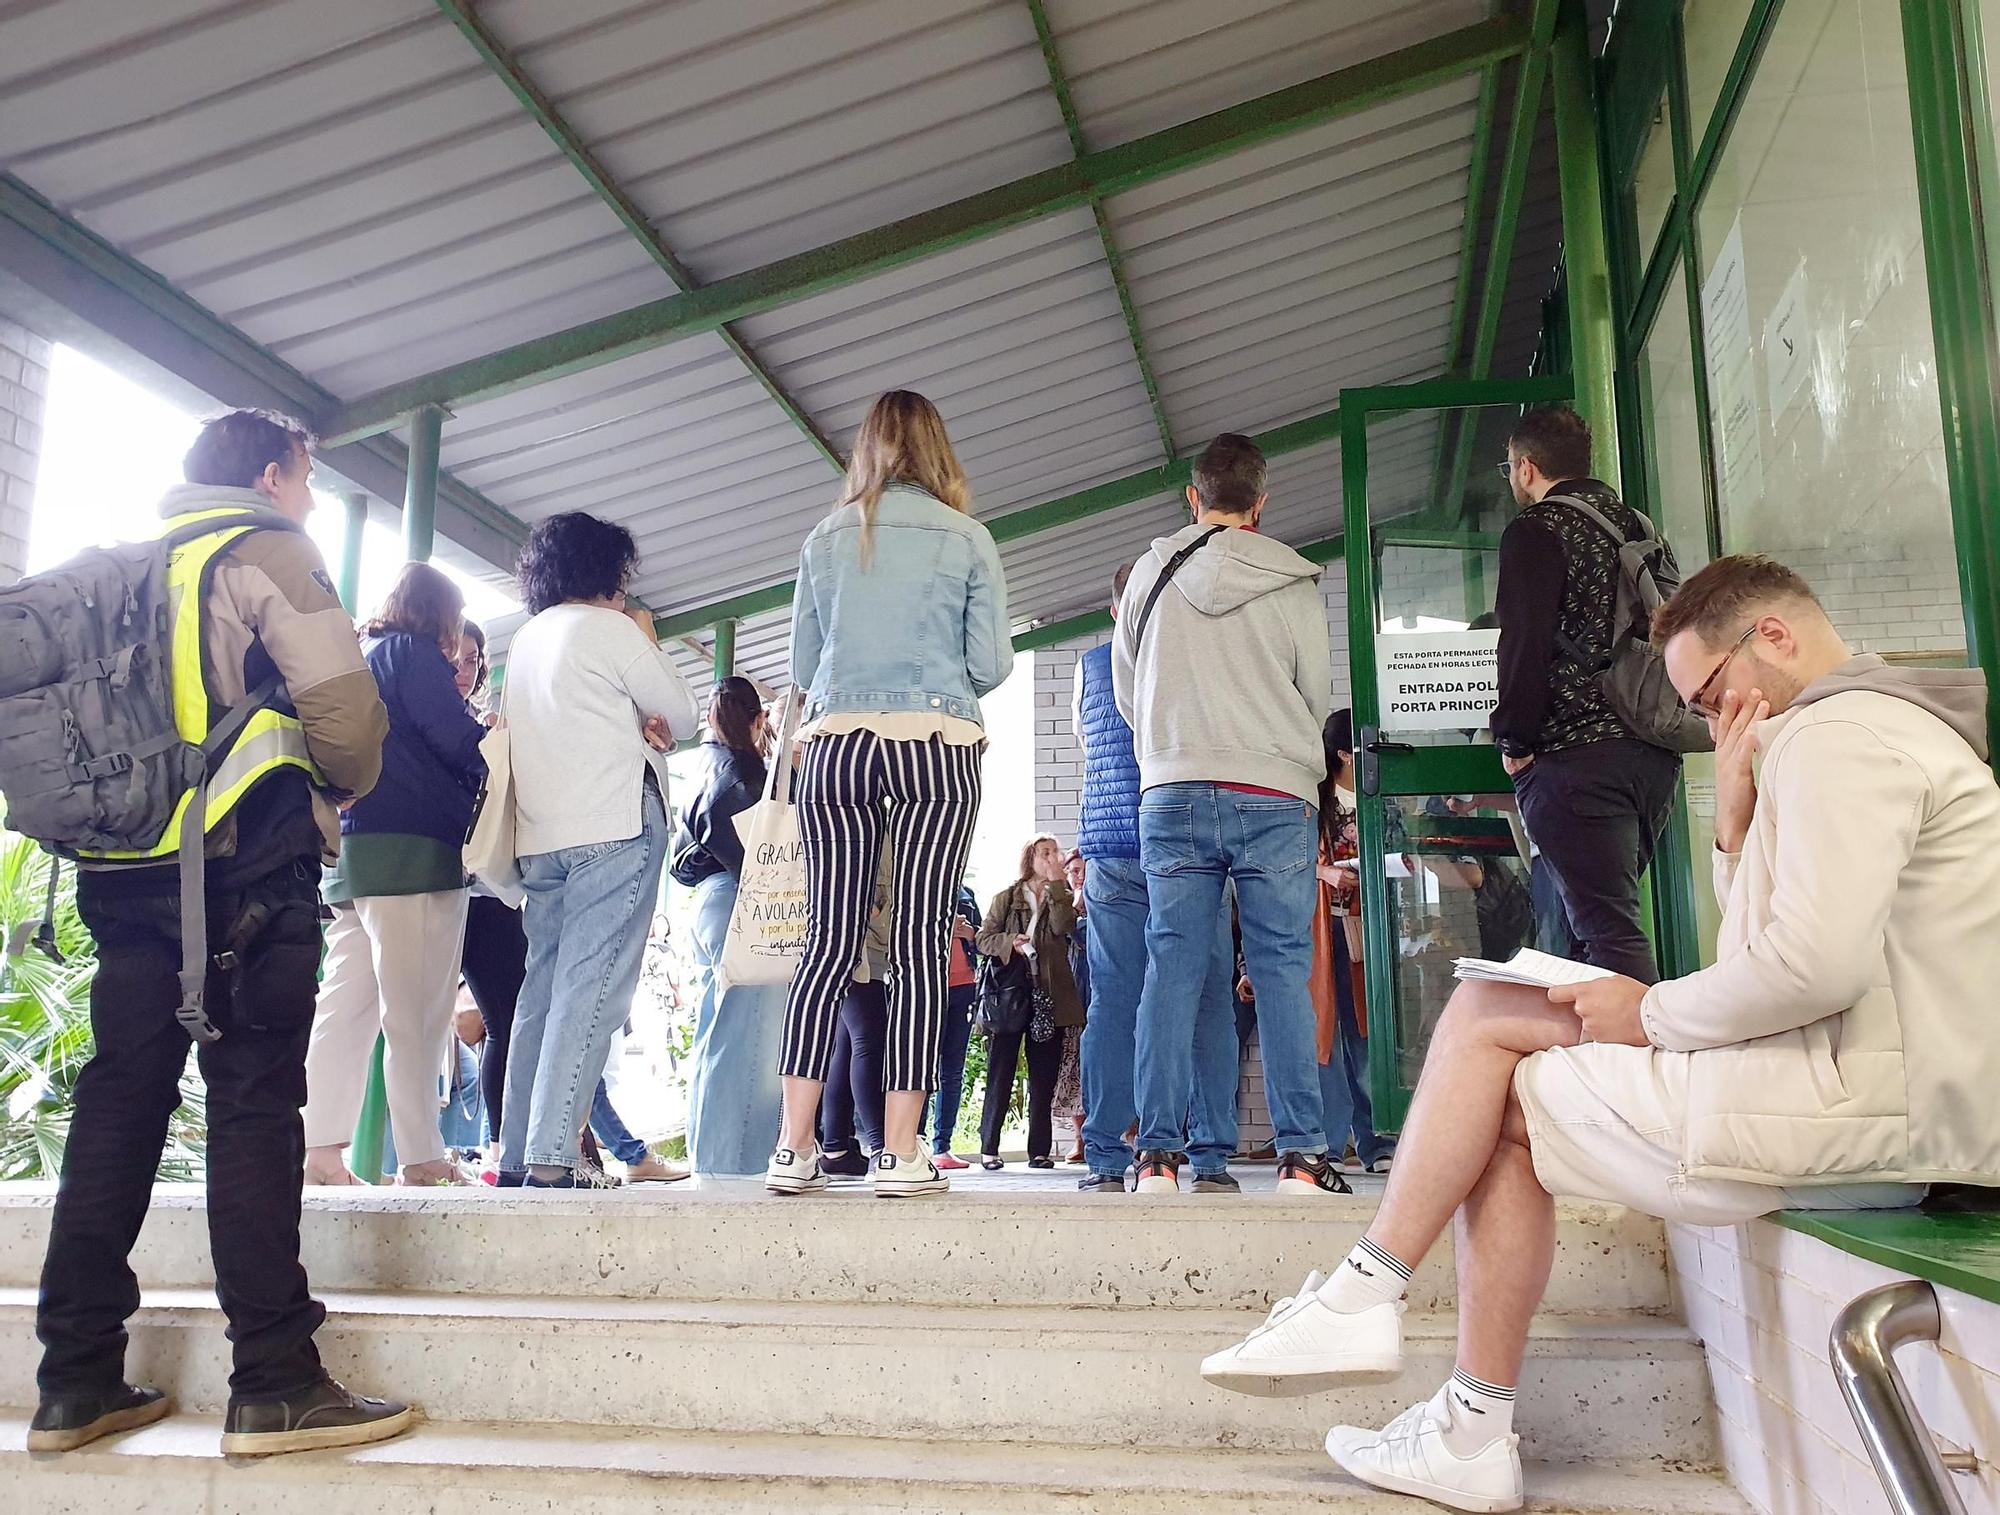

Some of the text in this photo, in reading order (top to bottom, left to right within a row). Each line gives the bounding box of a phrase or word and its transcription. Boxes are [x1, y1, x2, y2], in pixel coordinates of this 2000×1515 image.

[1394, 652, 1414, 660] ESTA
[1415, 651, 1442, 659] PORTA
[1387, 662, 1427, 670] PECHADA
[1428, 661, 1440, 669] EN
[1441, 660, 1470, 668] HORAS
[1399, 682, 1464, 694] ENTRADA
[1391, 701, 1436, 713] PORTA
[752, 901, 805, 921] A VOLAR
[768, 925, 781, 938] por
[785, 920, 794, 933] tu
